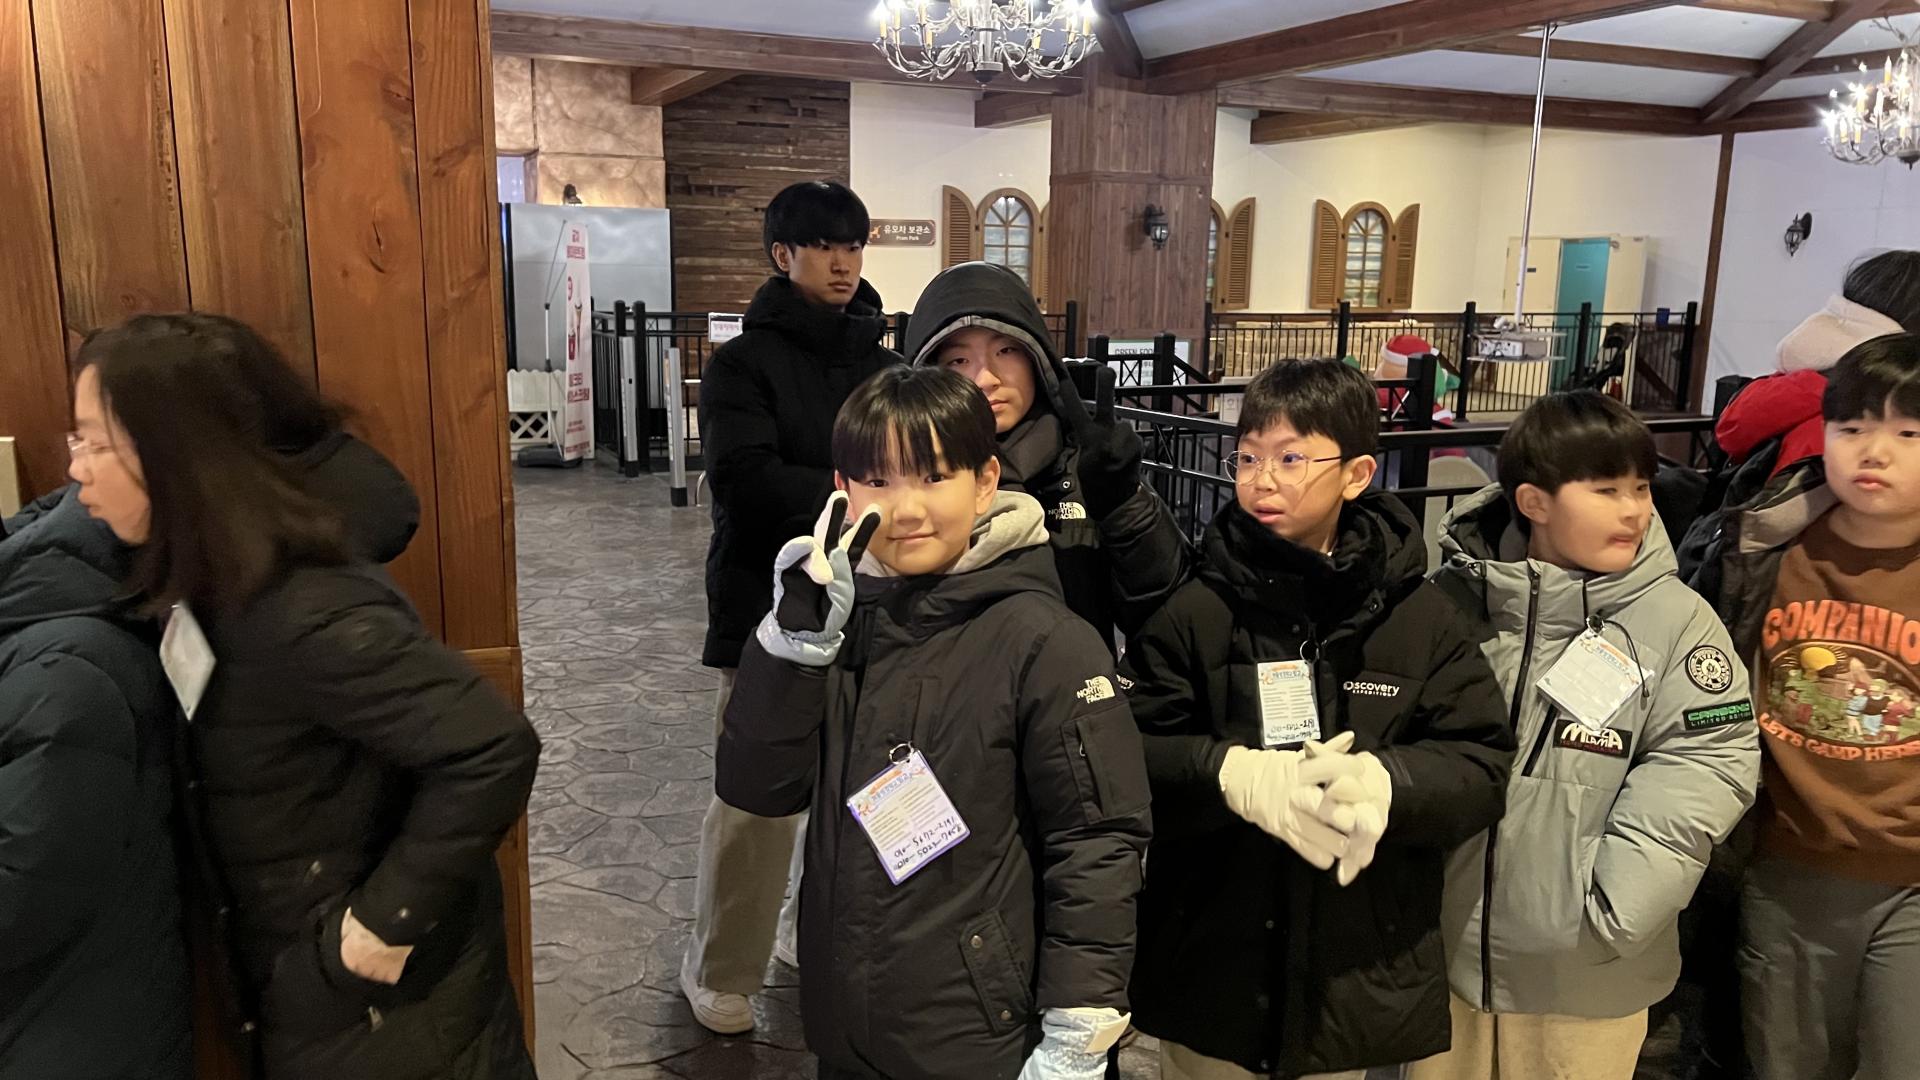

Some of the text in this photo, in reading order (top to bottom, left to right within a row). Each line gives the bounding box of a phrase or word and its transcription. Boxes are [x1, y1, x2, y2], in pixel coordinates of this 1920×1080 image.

[883, 224, 931, 235] 유모차 보관소
[1048, 506, 1069, 515] NORTH
[1077, 685, 1102, 698] NORTH
[1691, 716, 1726, 727] LIMITED
[1805, 739, 1862, 761] CAMP
